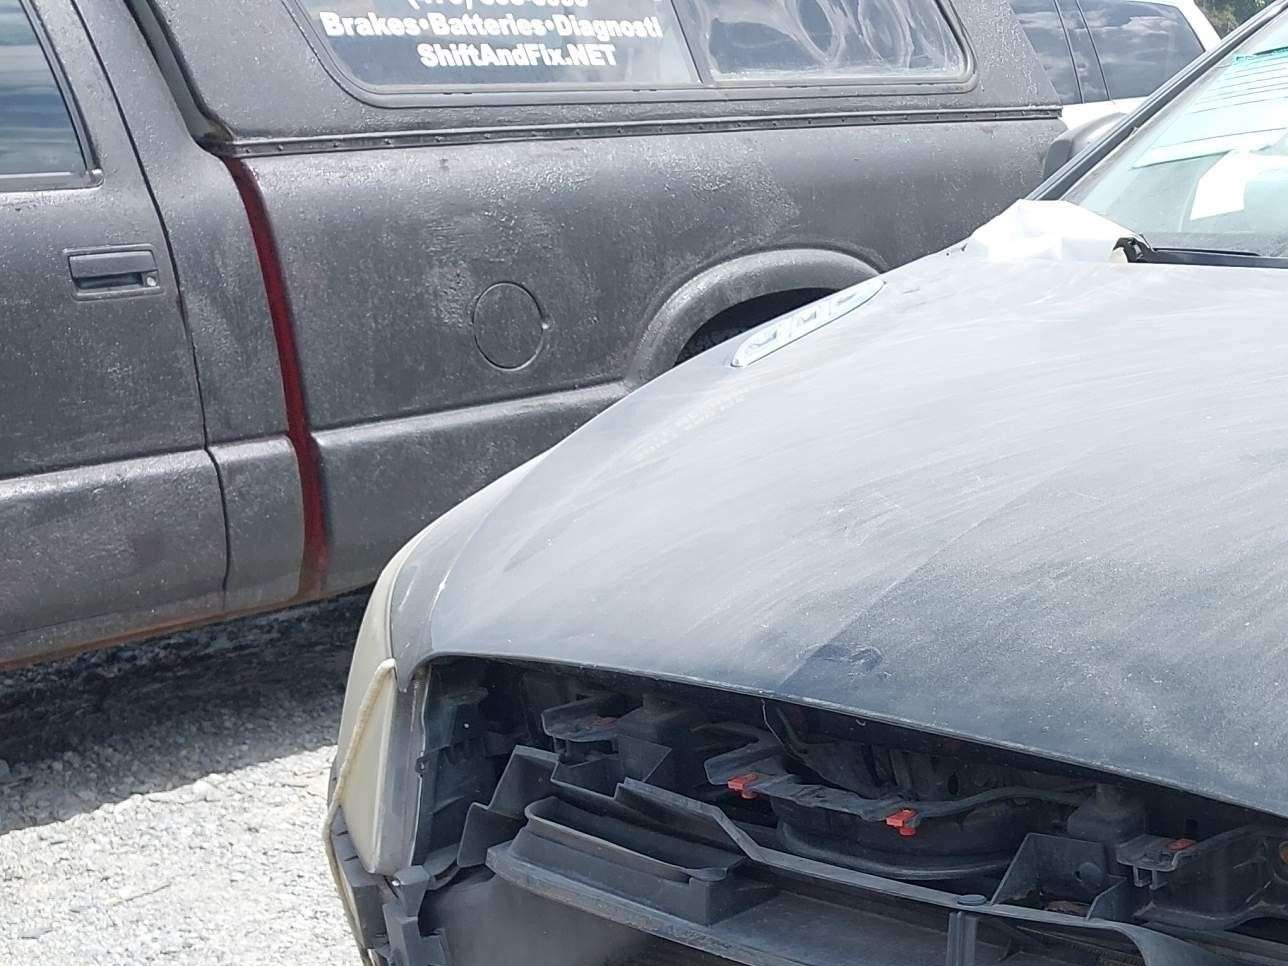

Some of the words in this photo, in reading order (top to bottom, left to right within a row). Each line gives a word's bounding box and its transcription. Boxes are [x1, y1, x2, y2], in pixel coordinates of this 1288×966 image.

[319, 12, 420, 37] Brakes
[427, 12, 547, 37] Batteries
[417, 43, 617, 68] ShiftAndFix.NET
